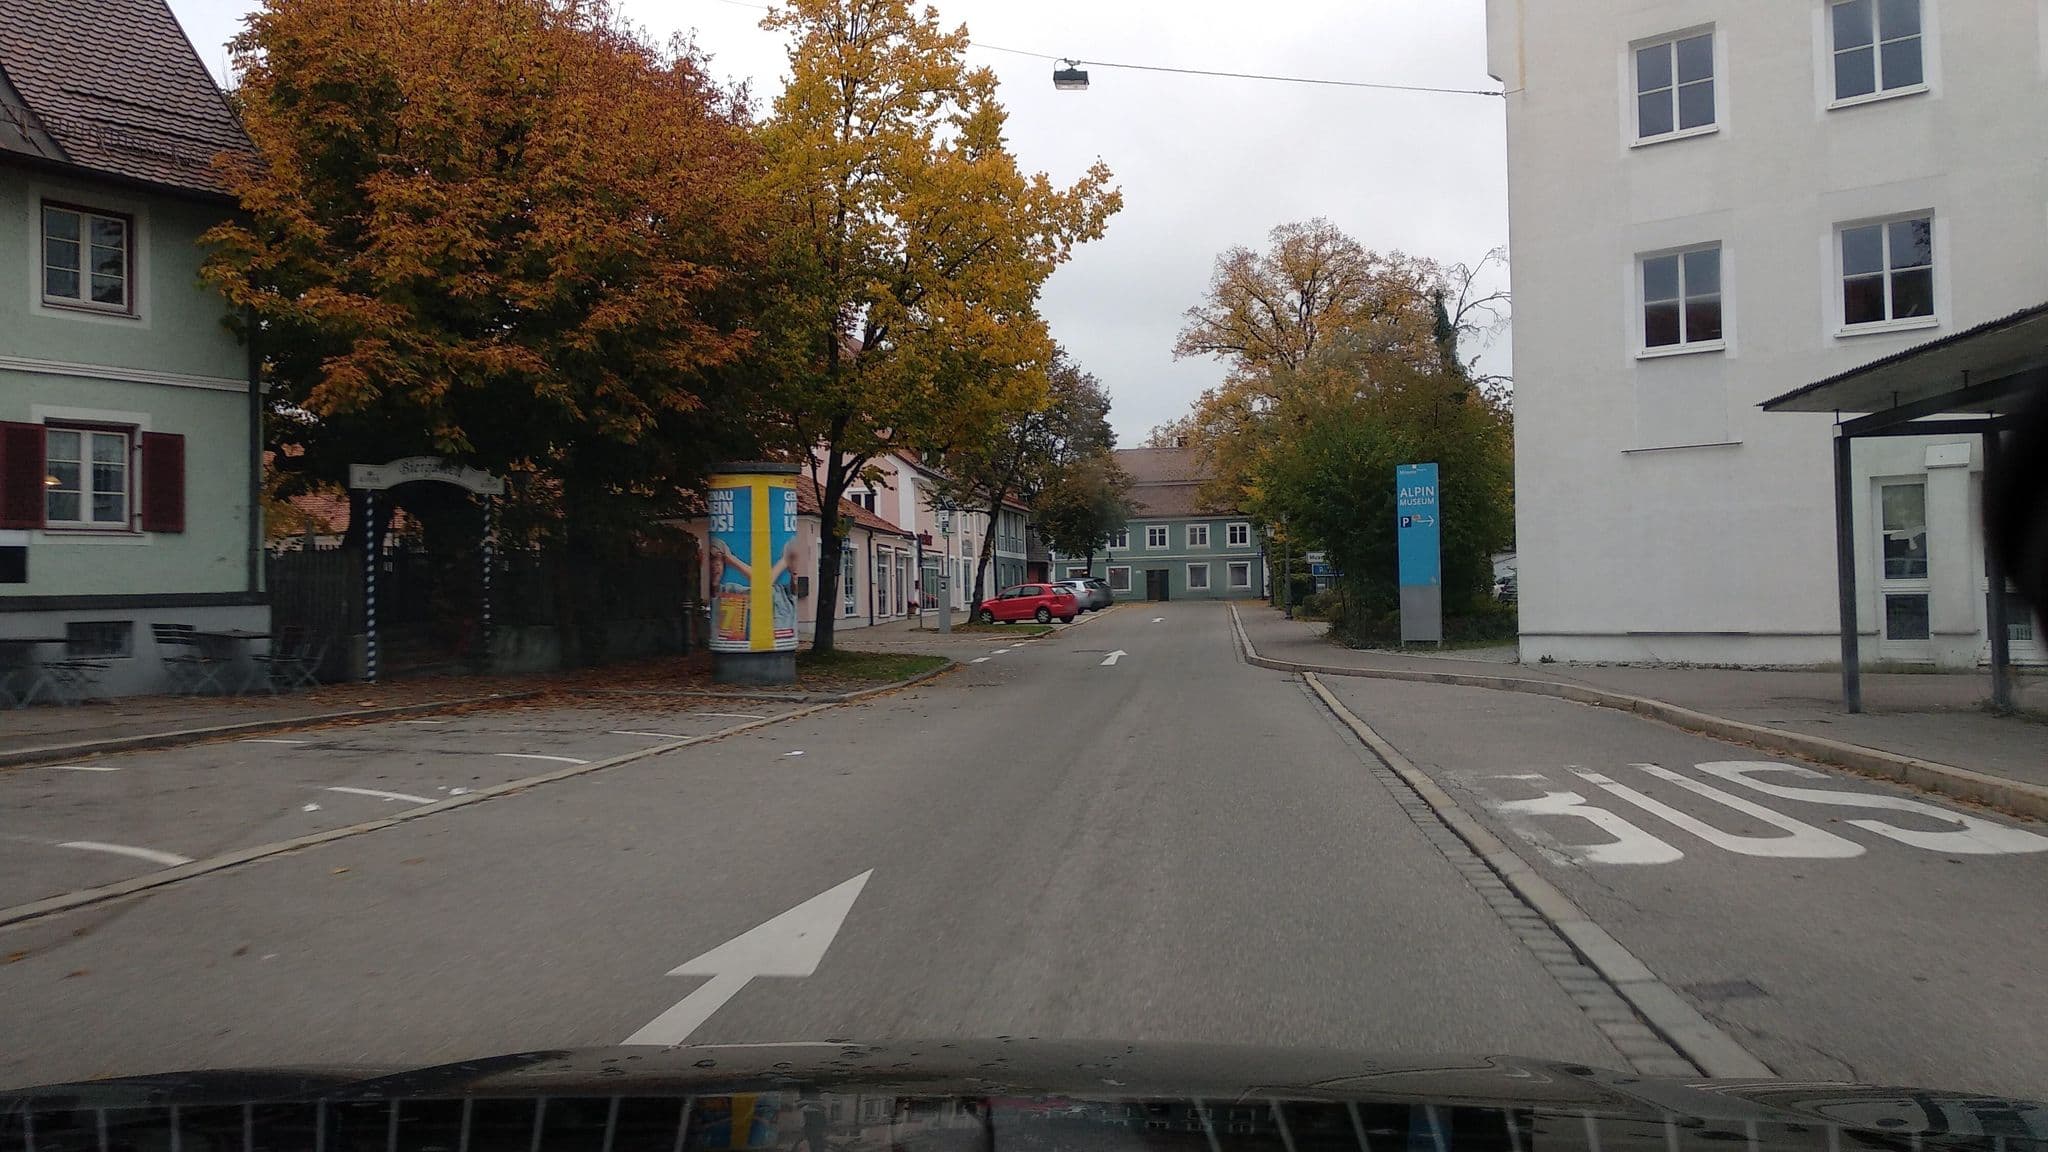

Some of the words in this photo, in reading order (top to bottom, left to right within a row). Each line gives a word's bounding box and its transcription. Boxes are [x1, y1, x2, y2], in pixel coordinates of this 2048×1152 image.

[1400, 486, 1434, 498] ALPIN
[1399, 498, 1434, 506] MUSEUM
[1478, 760, 2048, 865] BUS
